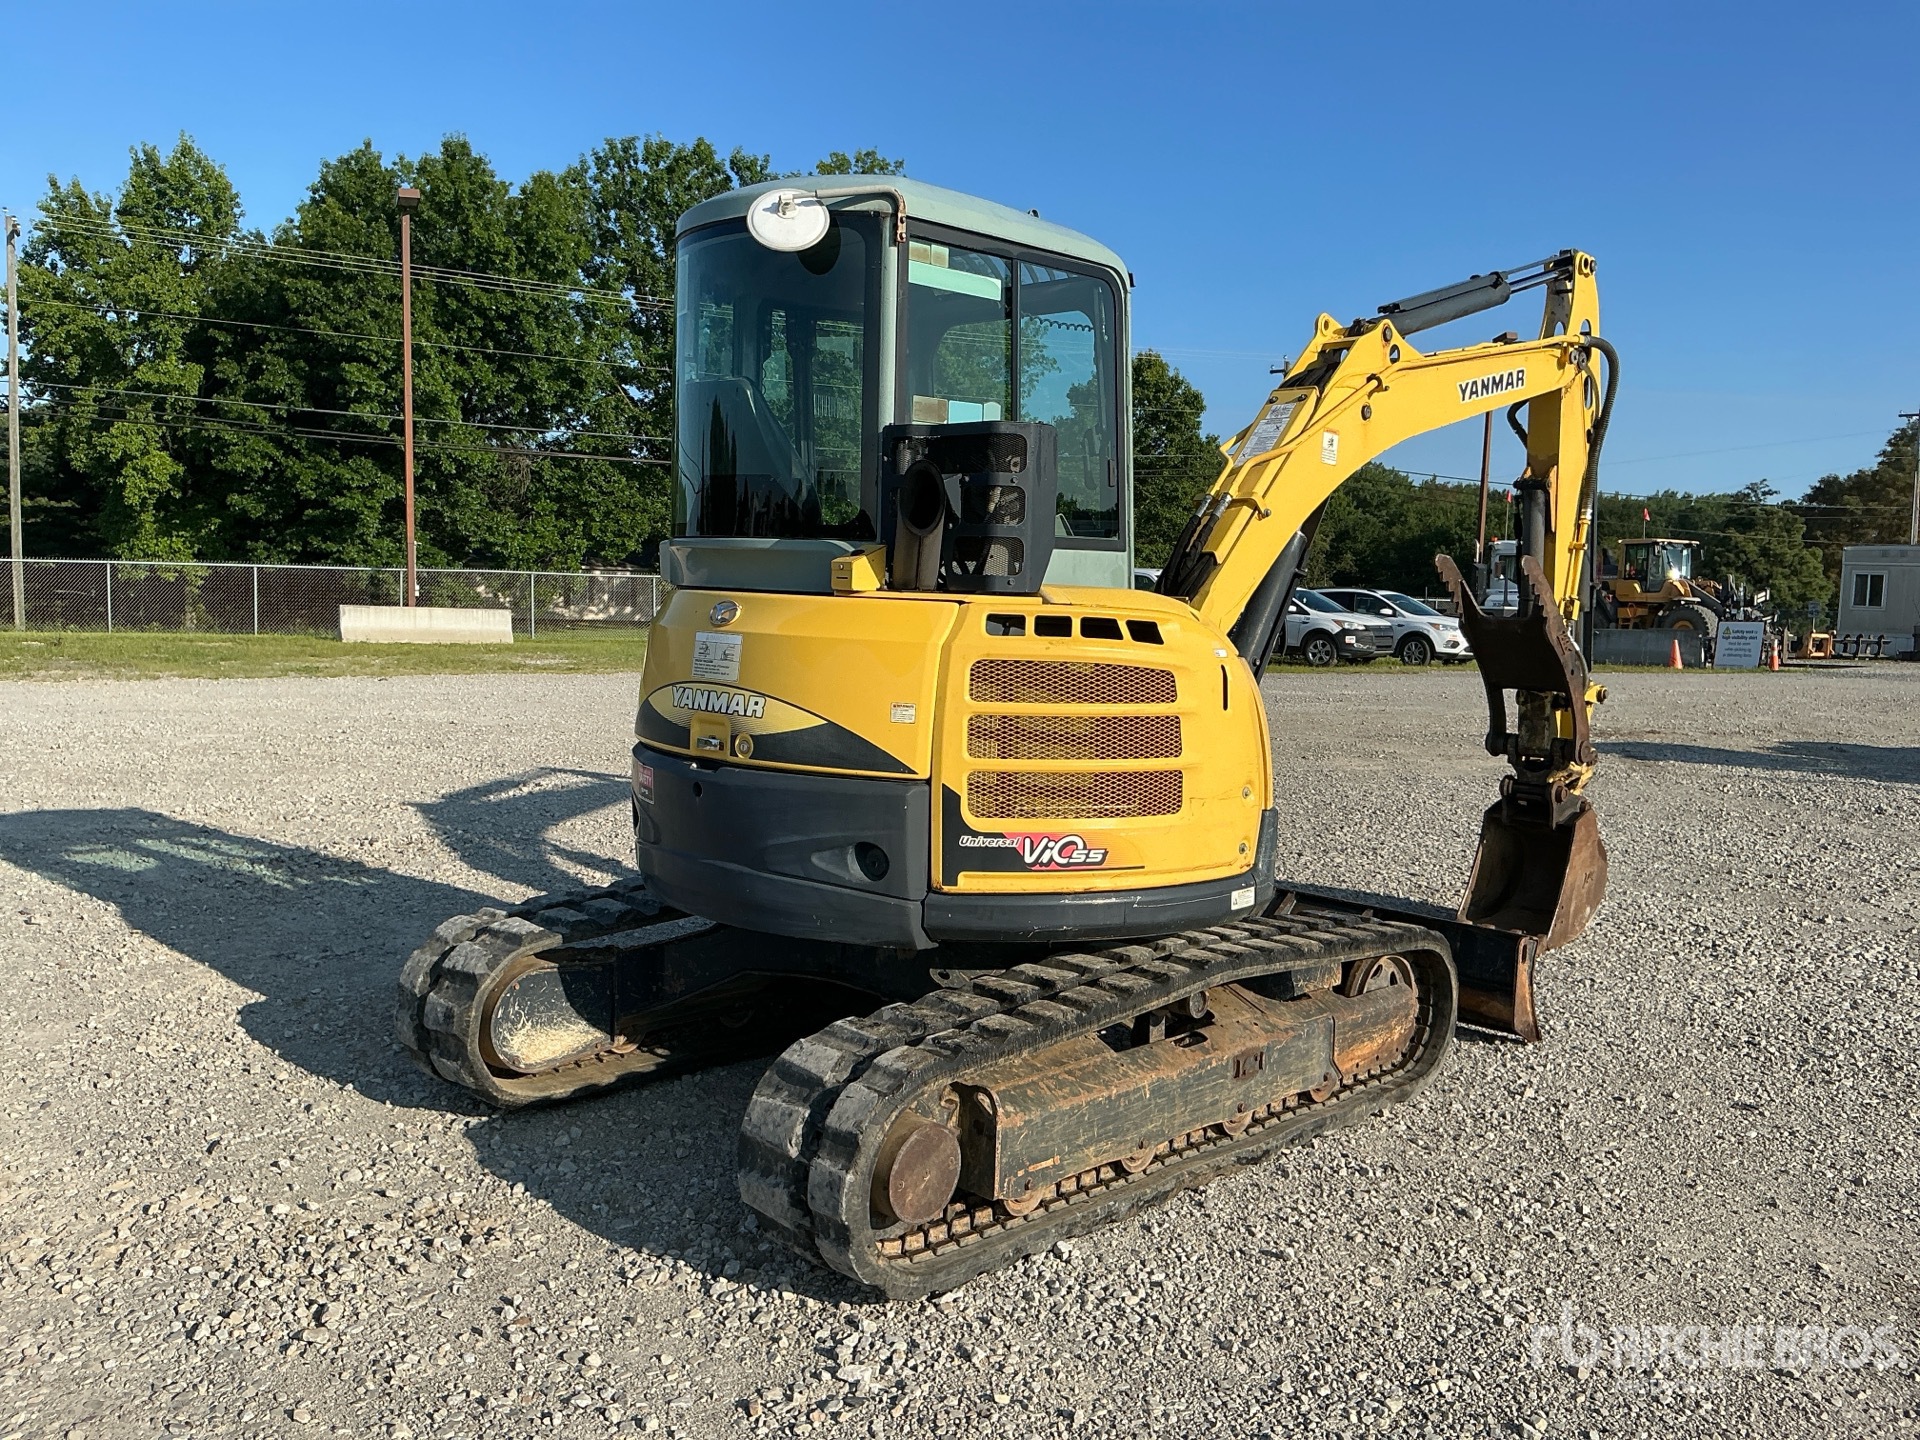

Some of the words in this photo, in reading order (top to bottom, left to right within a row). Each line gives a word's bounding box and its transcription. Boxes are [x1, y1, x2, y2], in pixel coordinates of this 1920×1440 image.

[1458, 368, 1526, 402] YANMAR
[672, 686, 767, 719] YANMAR
[959, 836, 1020, 847] Universal
